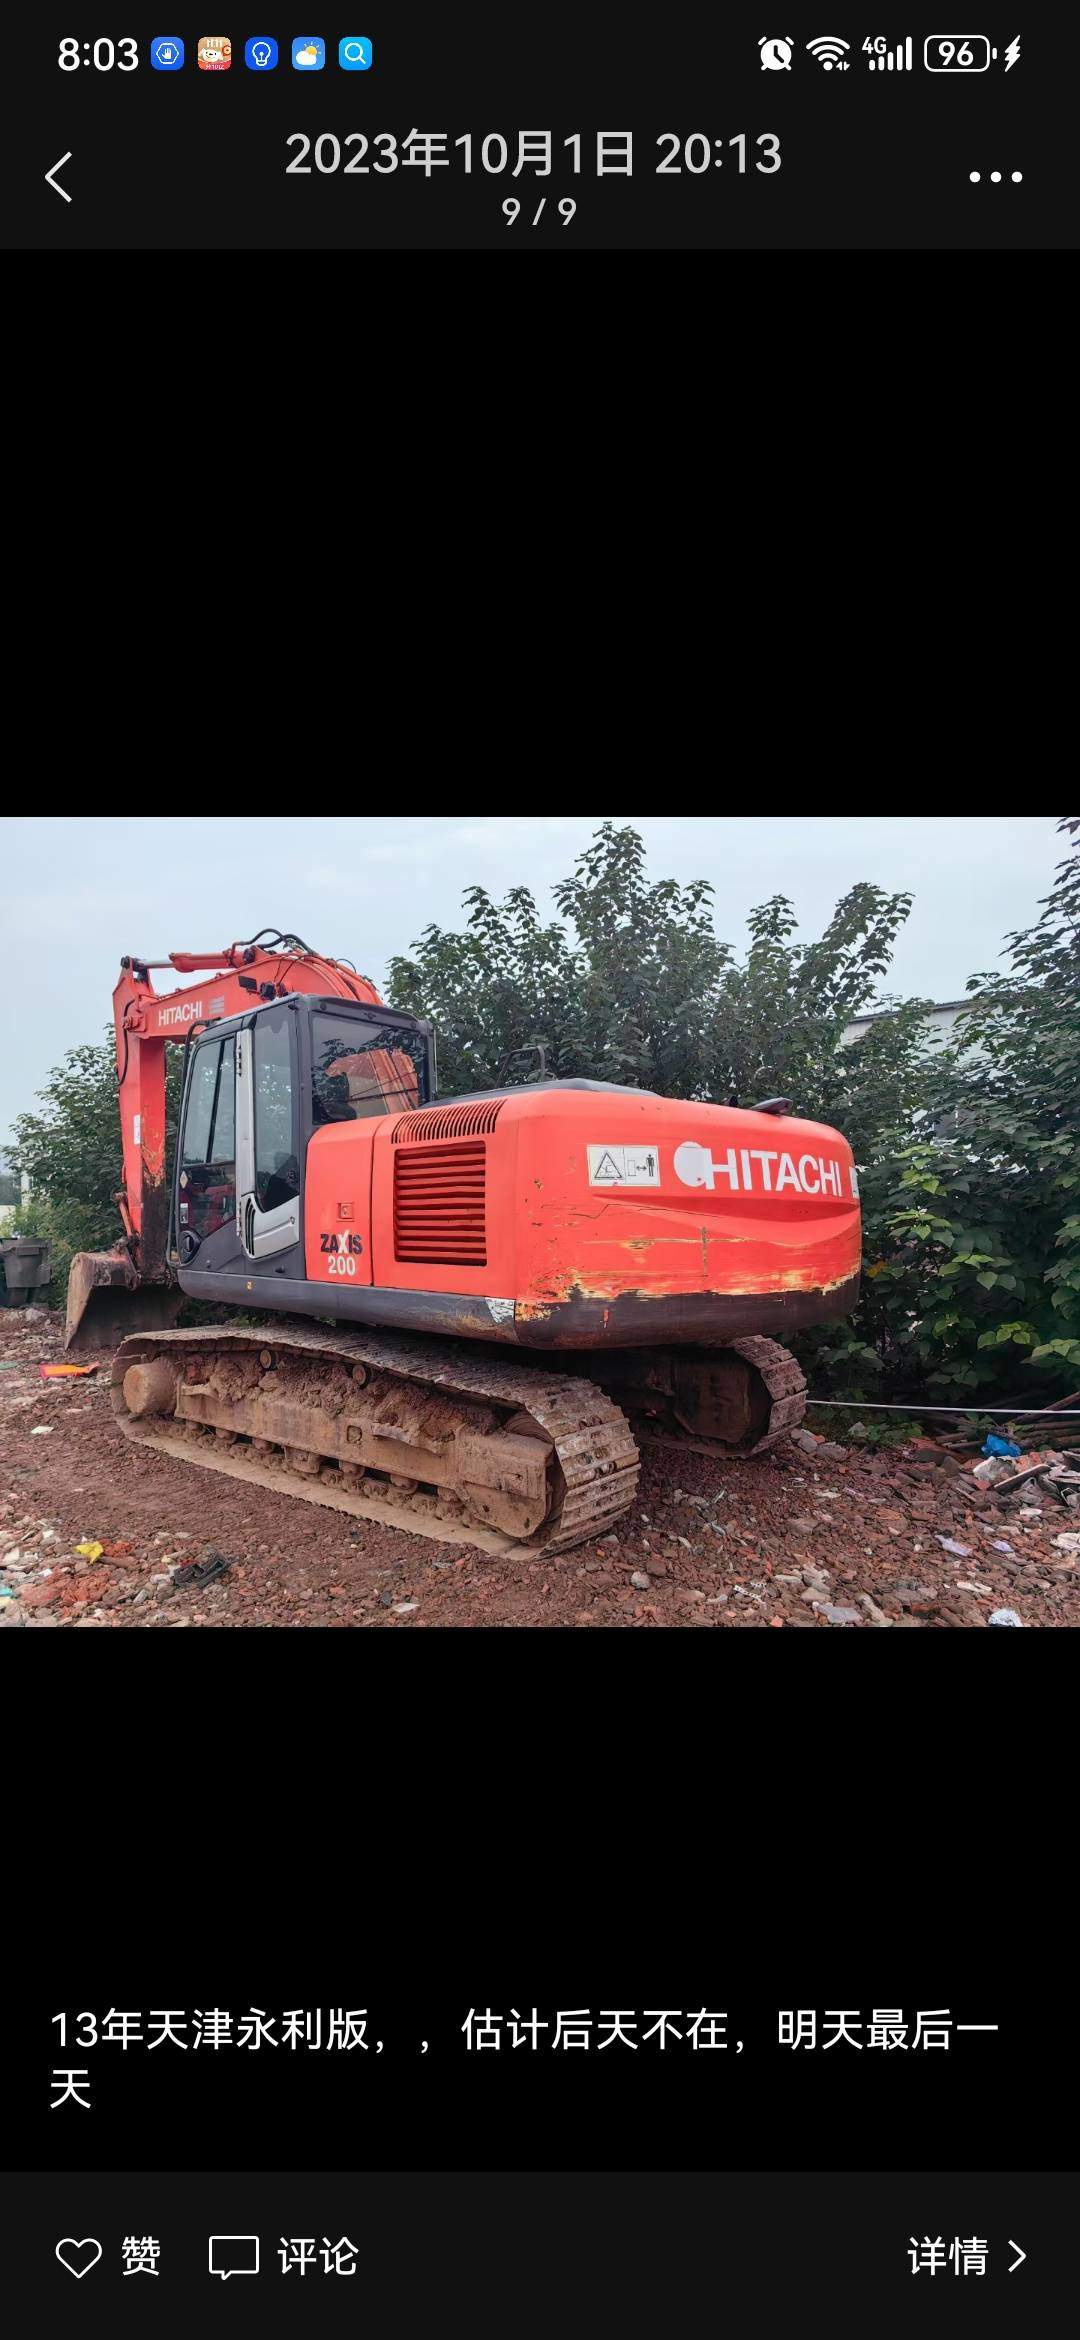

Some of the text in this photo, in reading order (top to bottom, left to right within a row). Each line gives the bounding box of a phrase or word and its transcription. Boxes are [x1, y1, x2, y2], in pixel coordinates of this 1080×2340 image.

[158, 1001, 203, 1026] HITACHI
[704, 1148, 842, 1198] HITACHI
[320, 1229, 363, 1254] ZAXIS
[328, 1255, 356, 1276] 200
